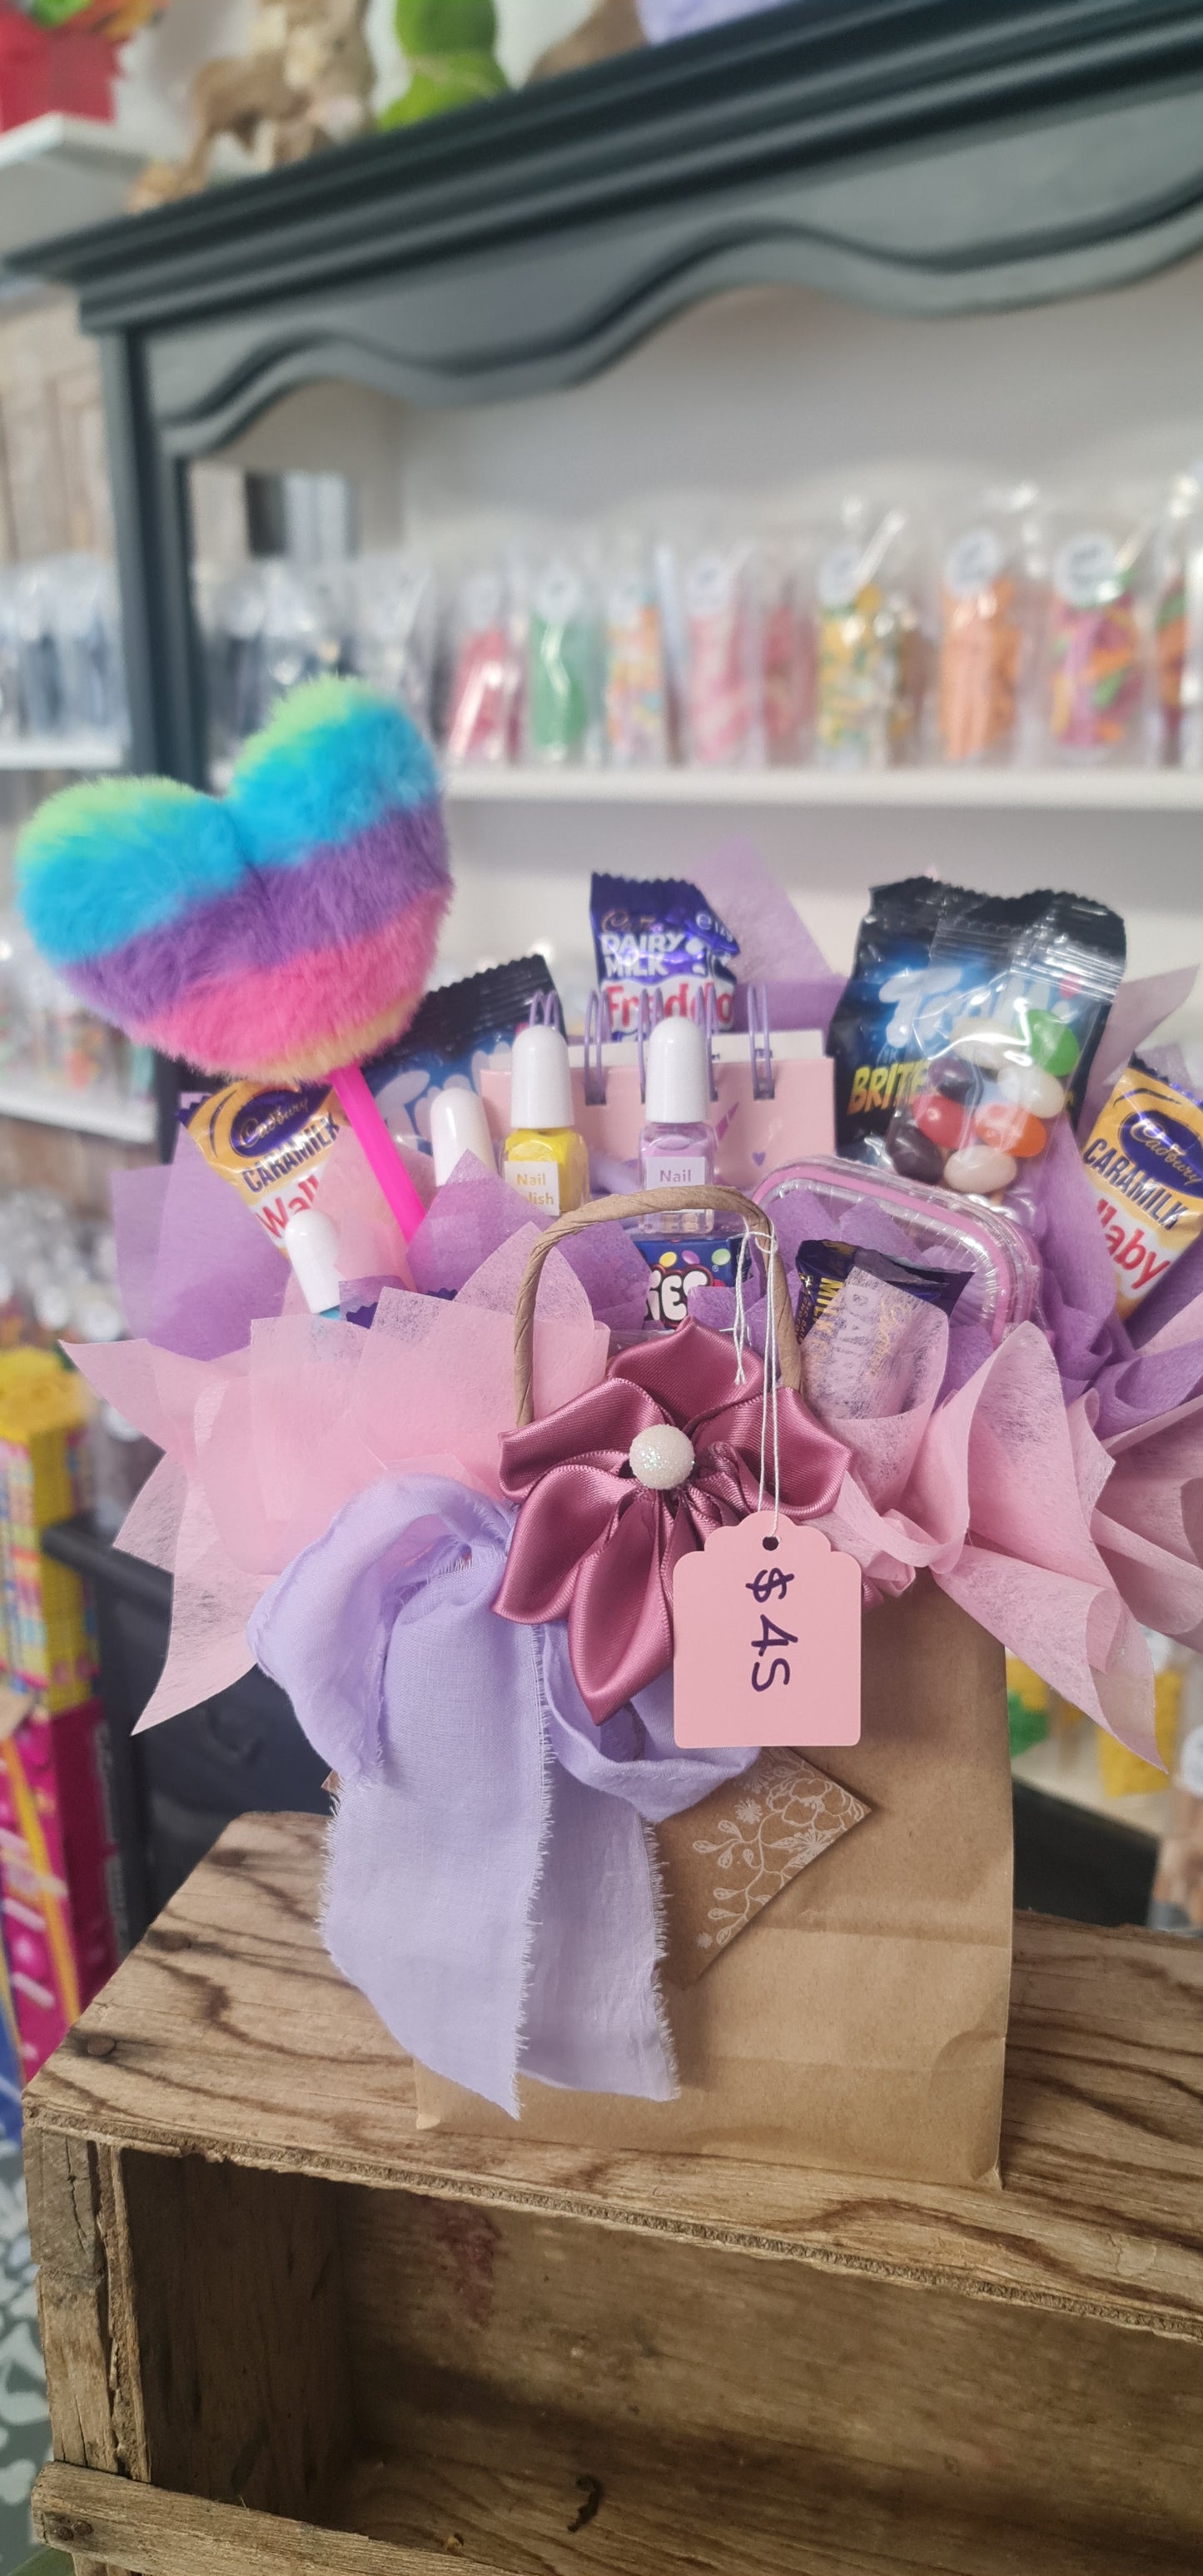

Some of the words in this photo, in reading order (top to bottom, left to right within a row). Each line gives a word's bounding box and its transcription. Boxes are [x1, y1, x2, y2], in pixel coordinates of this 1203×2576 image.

[600, 932, 685, 957] DAIRY
[604, 952, 669, 978] MILK
[241, 1111, 340, 1193] CARAMILK
[1130, 1120, 1202, 1186] Cadbury
[516, 1173, 546, 1186] Nail
[659, 1170, 692, 1183] Nail
[1082, 1137, 1189, 1231] CARAMILK
